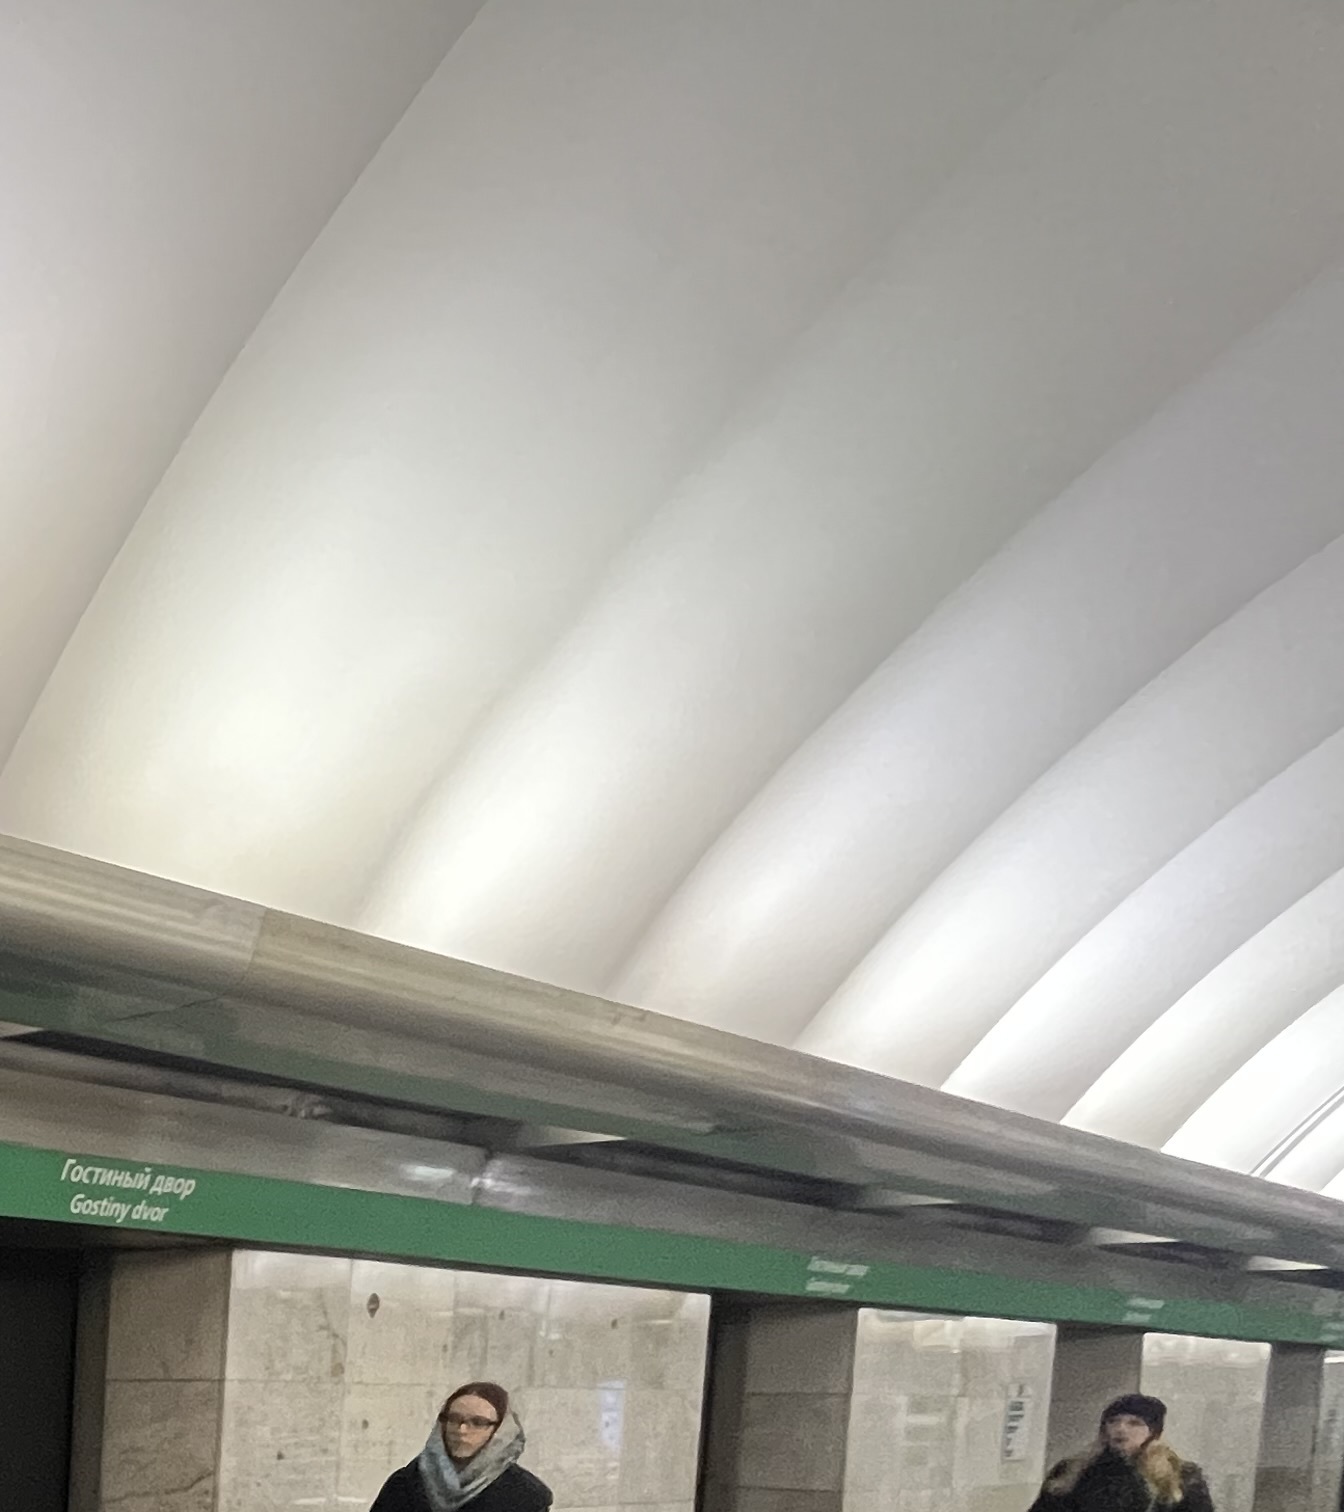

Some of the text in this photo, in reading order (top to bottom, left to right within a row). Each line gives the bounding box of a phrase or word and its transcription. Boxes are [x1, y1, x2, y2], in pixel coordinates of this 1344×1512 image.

[60, 1158, 196, 1200] Гостиный двор
[70, 1193, 170, 1223] Gostiny dvor
